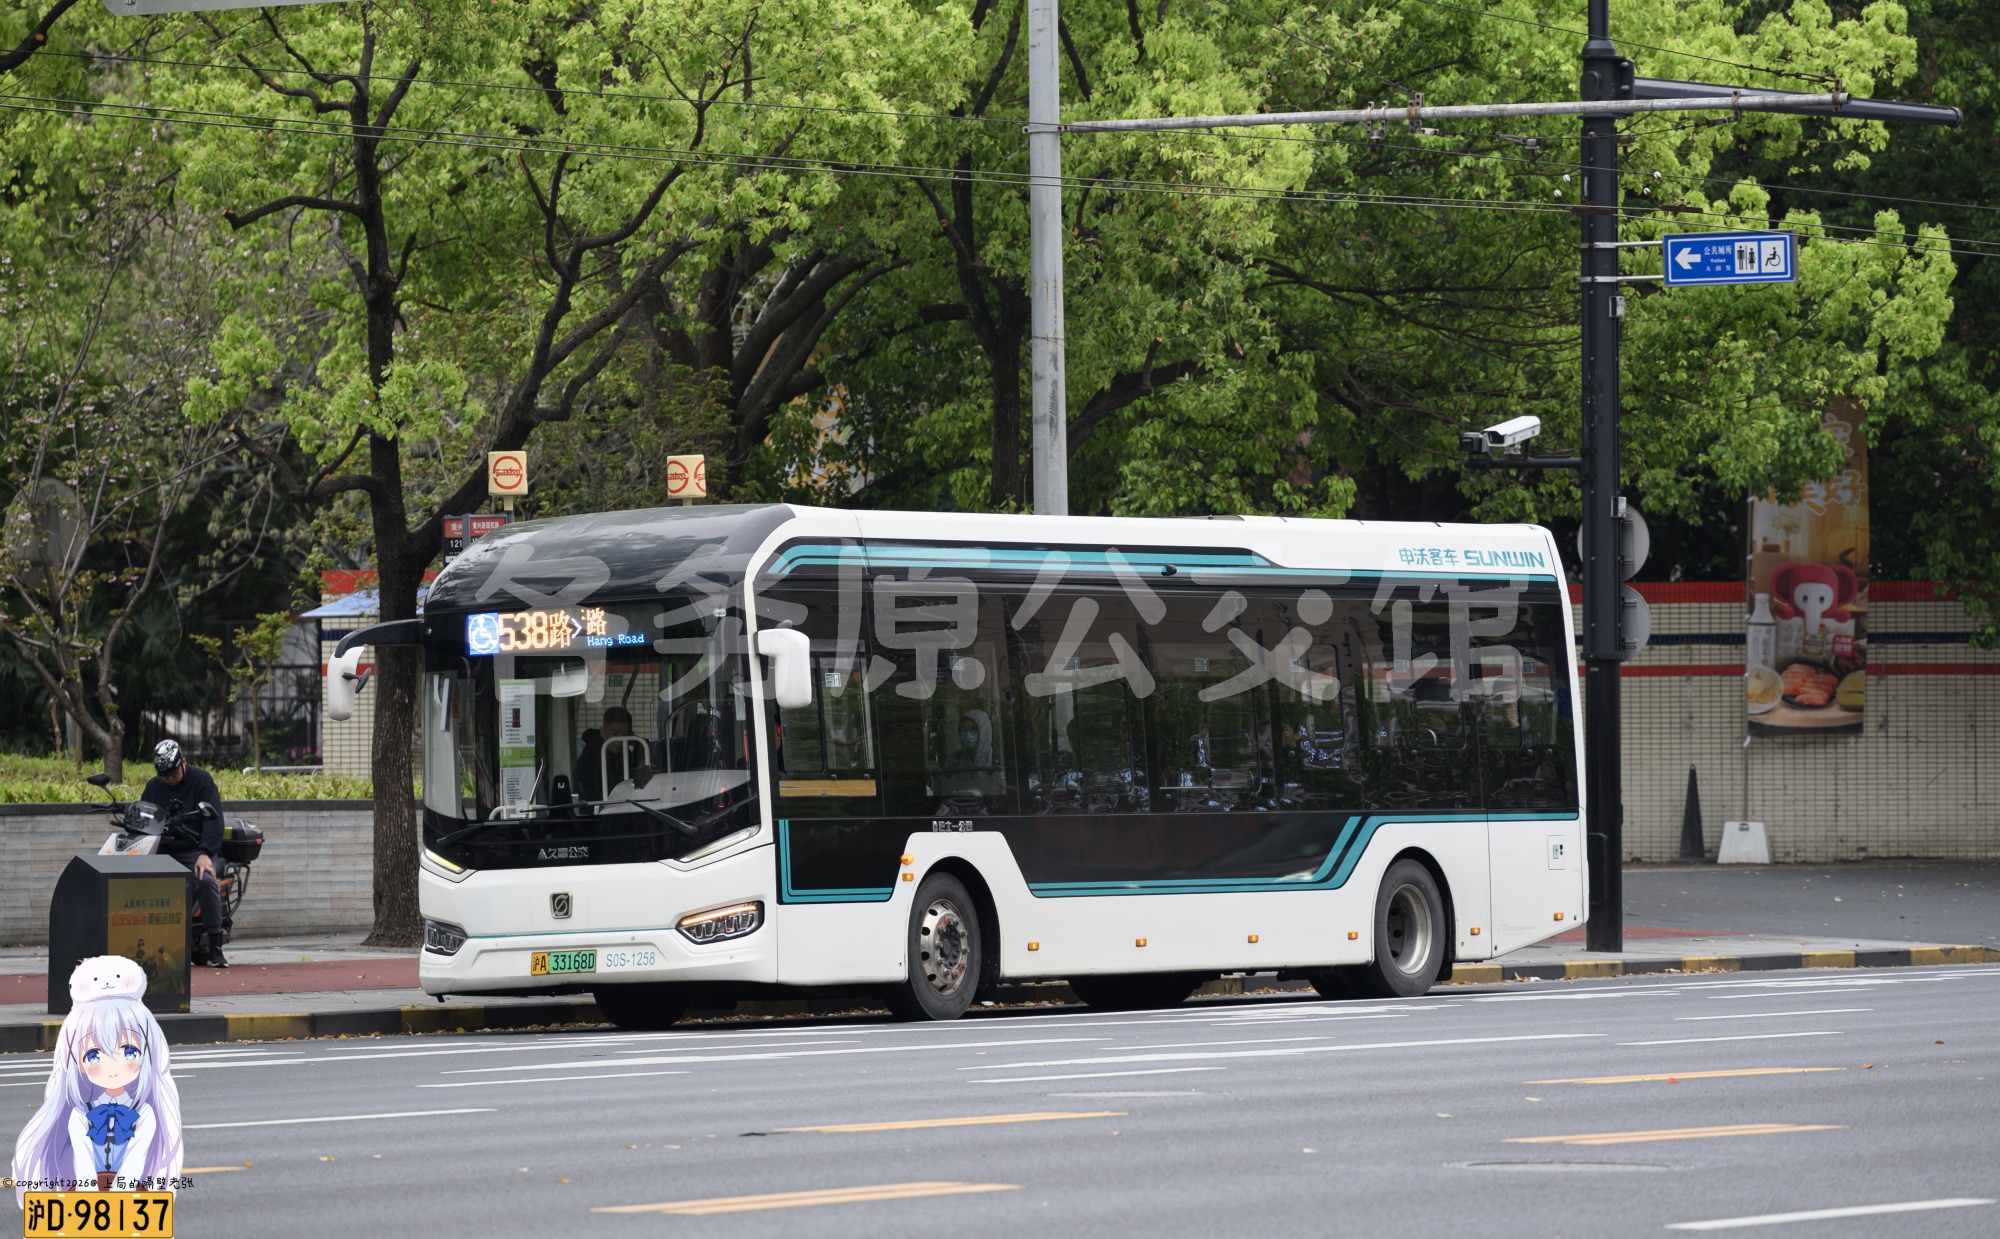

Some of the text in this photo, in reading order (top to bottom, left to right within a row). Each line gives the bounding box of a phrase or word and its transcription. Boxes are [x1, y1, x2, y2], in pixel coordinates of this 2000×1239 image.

[1703, 245, 1732, 256] 公共厕所
[1399, 547, 1545, 568] 申沃客车 SUNWIN
[498, 609, 572, 651] 538路
[587, 633, 645, 647] Hang Road
